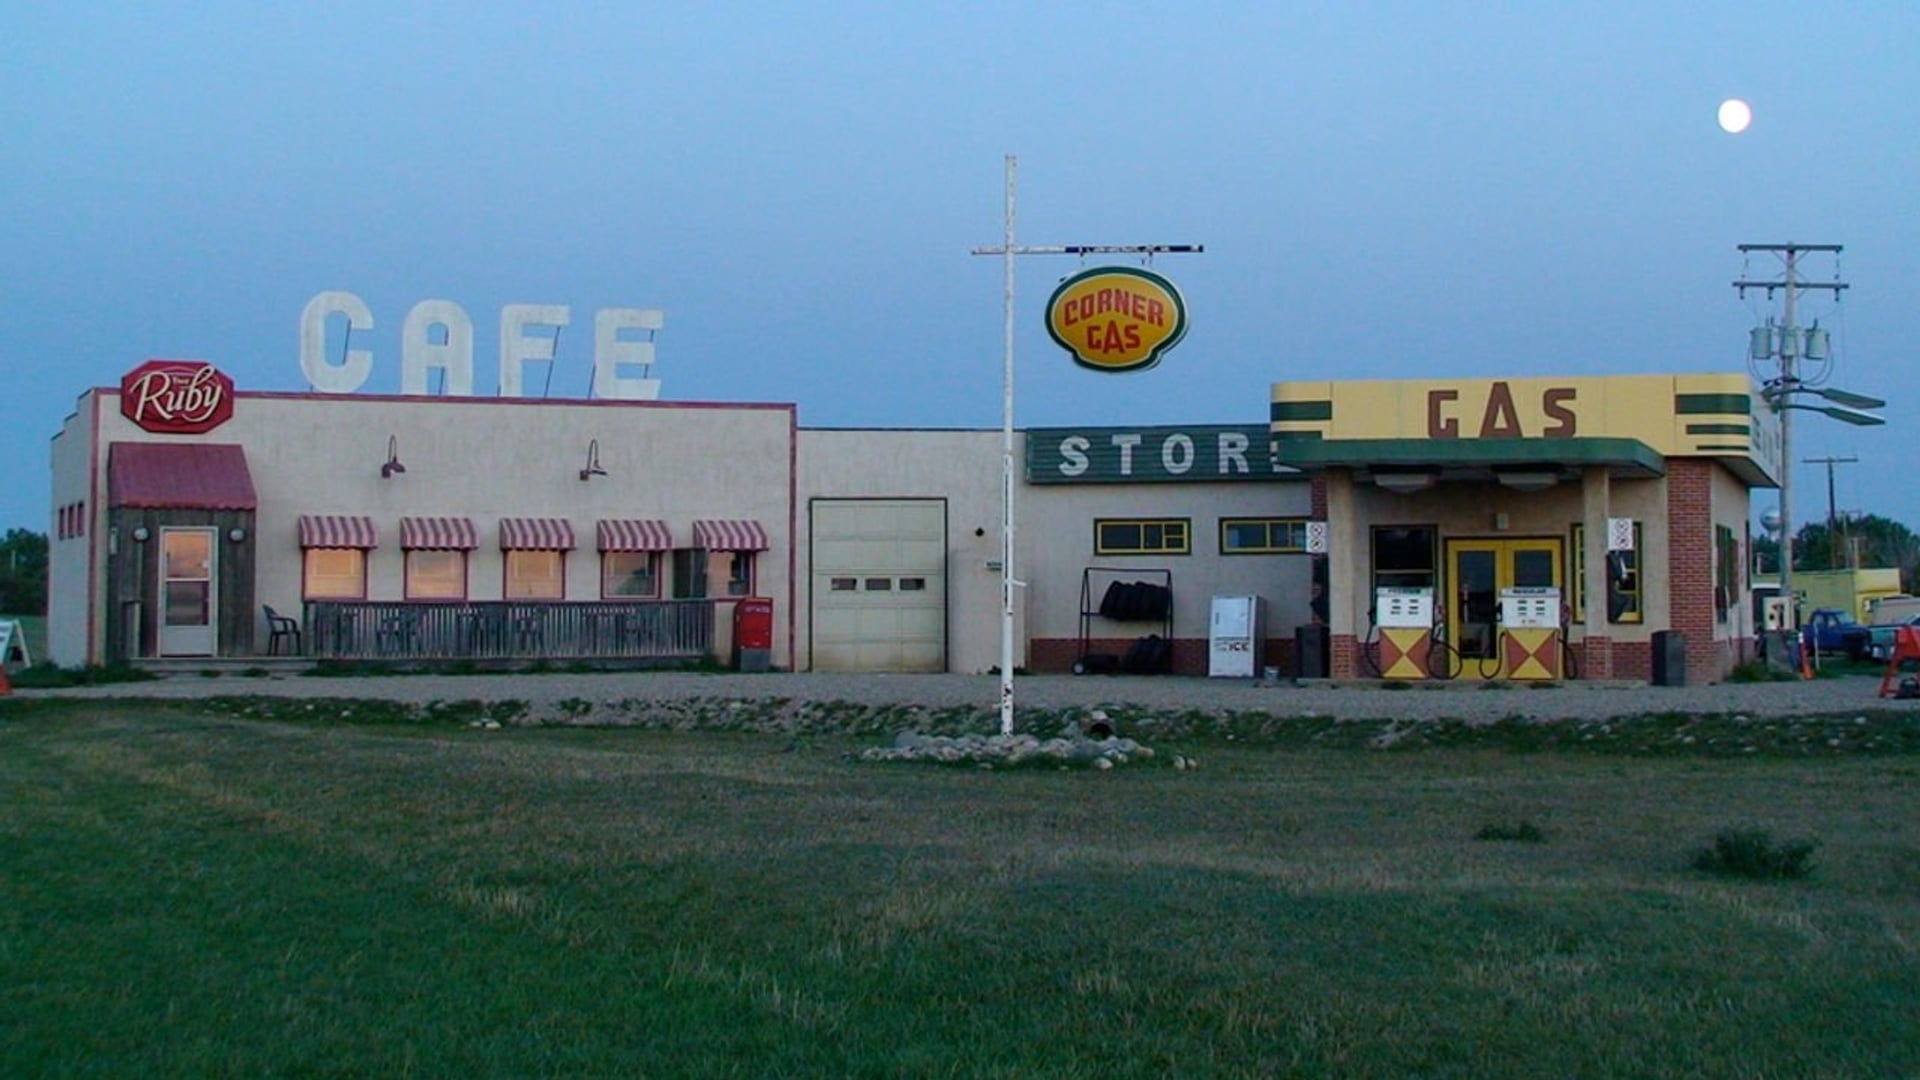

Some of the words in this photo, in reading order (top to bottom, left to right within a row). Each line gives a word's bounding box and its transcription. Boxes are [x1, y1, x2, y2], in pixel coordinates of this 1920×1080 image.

[1064, 288, 1164, 327] CORNER
[301, 291, 664, 399] CAFE
[1086, 320, 1142, 354] GAS
[129, 366, 222, 422] Ruby
[1428, 381, 1577, 438] GAS
[1228, 641, 1249, 652] ICE
